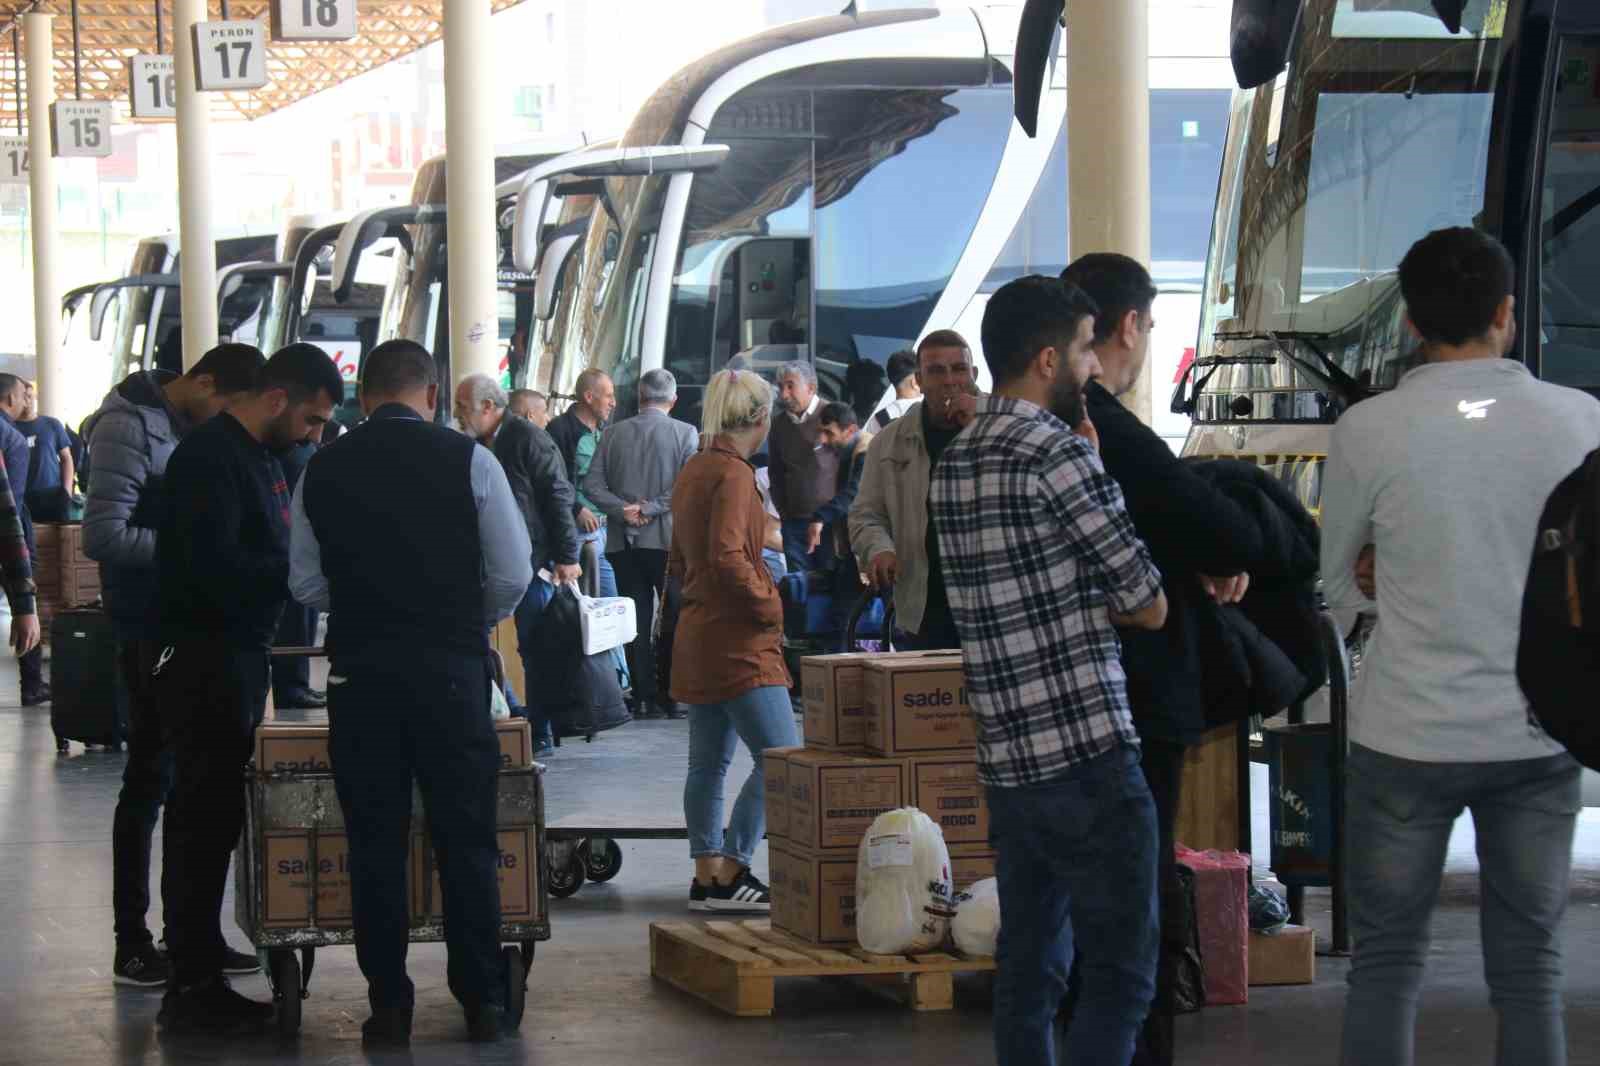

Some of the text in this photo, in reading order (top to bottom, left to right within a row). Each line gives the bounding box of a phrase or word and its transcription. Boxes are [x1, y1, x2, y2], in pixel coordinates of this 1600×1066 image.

[302, 0, 338, 27] 18
[210, 28, 254, 37] PERON
[214, 41, 252, 79] 17
[147, 74, 176, 108] 16
[69, 118, 101, 148] 15
[8, 150, 31, 176] 14
[903, 687, 953, 708] sade
